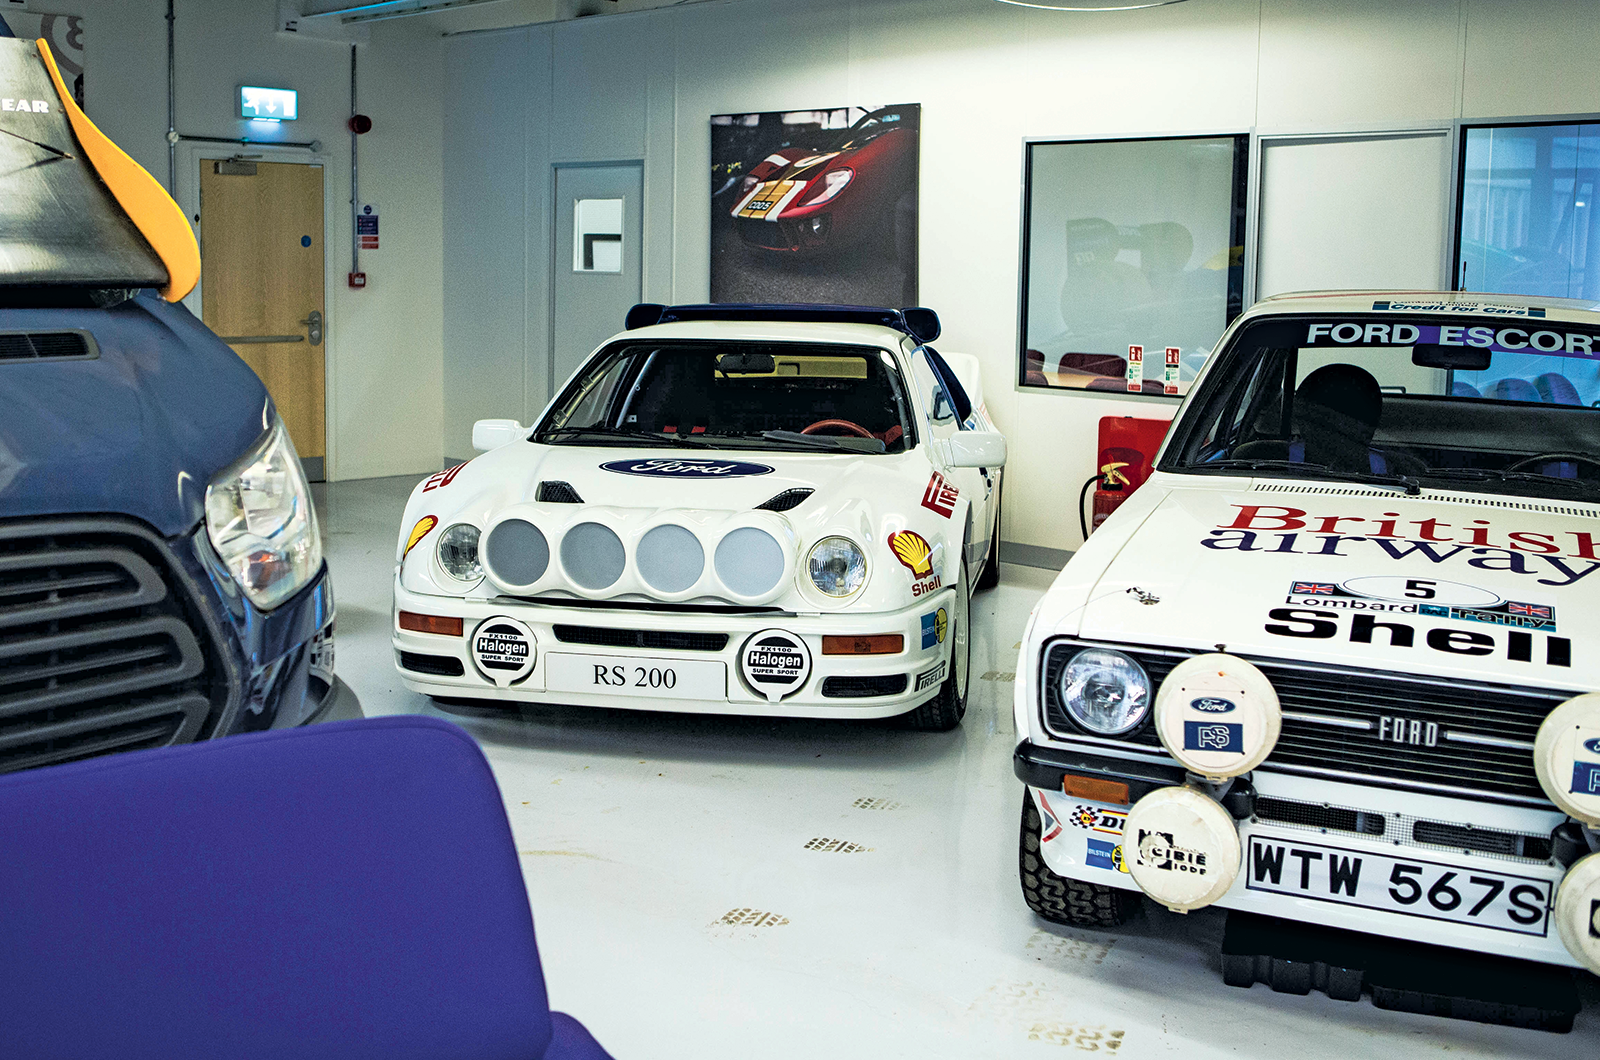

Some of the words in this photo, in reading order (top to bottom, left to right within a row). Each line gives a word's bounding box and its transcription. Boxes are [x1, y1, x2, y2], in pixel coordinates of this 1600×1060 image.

[1482, 307, 1526, 315] Cars
[1306, 322, 1420, 344] FORD
[630, 459, 733, 475] Ford
[921, 470, 959, 519] PIRE
[911, 575, 942, 597] Shell
[1404, 579, 1437, 599] 5
[1285, 595, 1418, 614] Lombard
[1458, 609, 1547, 629] rally
[478, 639, 527, 656] Halogen
[1264, 607, 1571, 668] Shell
[749, 651, 802, 668] Halogen
[592, 664, 627, 686] RS
[634, 667, 677, 689] 200
[752, 667, 774, 675] SUPER
[776, 668, 799, 676] SPORT
[914, 659, 946, 692] PIRELLI
[1198, 698, 1229, 713] Ford
[1198, 725, 1231, 749] RS
[1378, 715, 1439, 748] FORD
[1088, 848, 1111, 858] BILSTEIN
[1252, 842, 1363, 898] WTW
[1387, 863, 1545, 925] 567S
